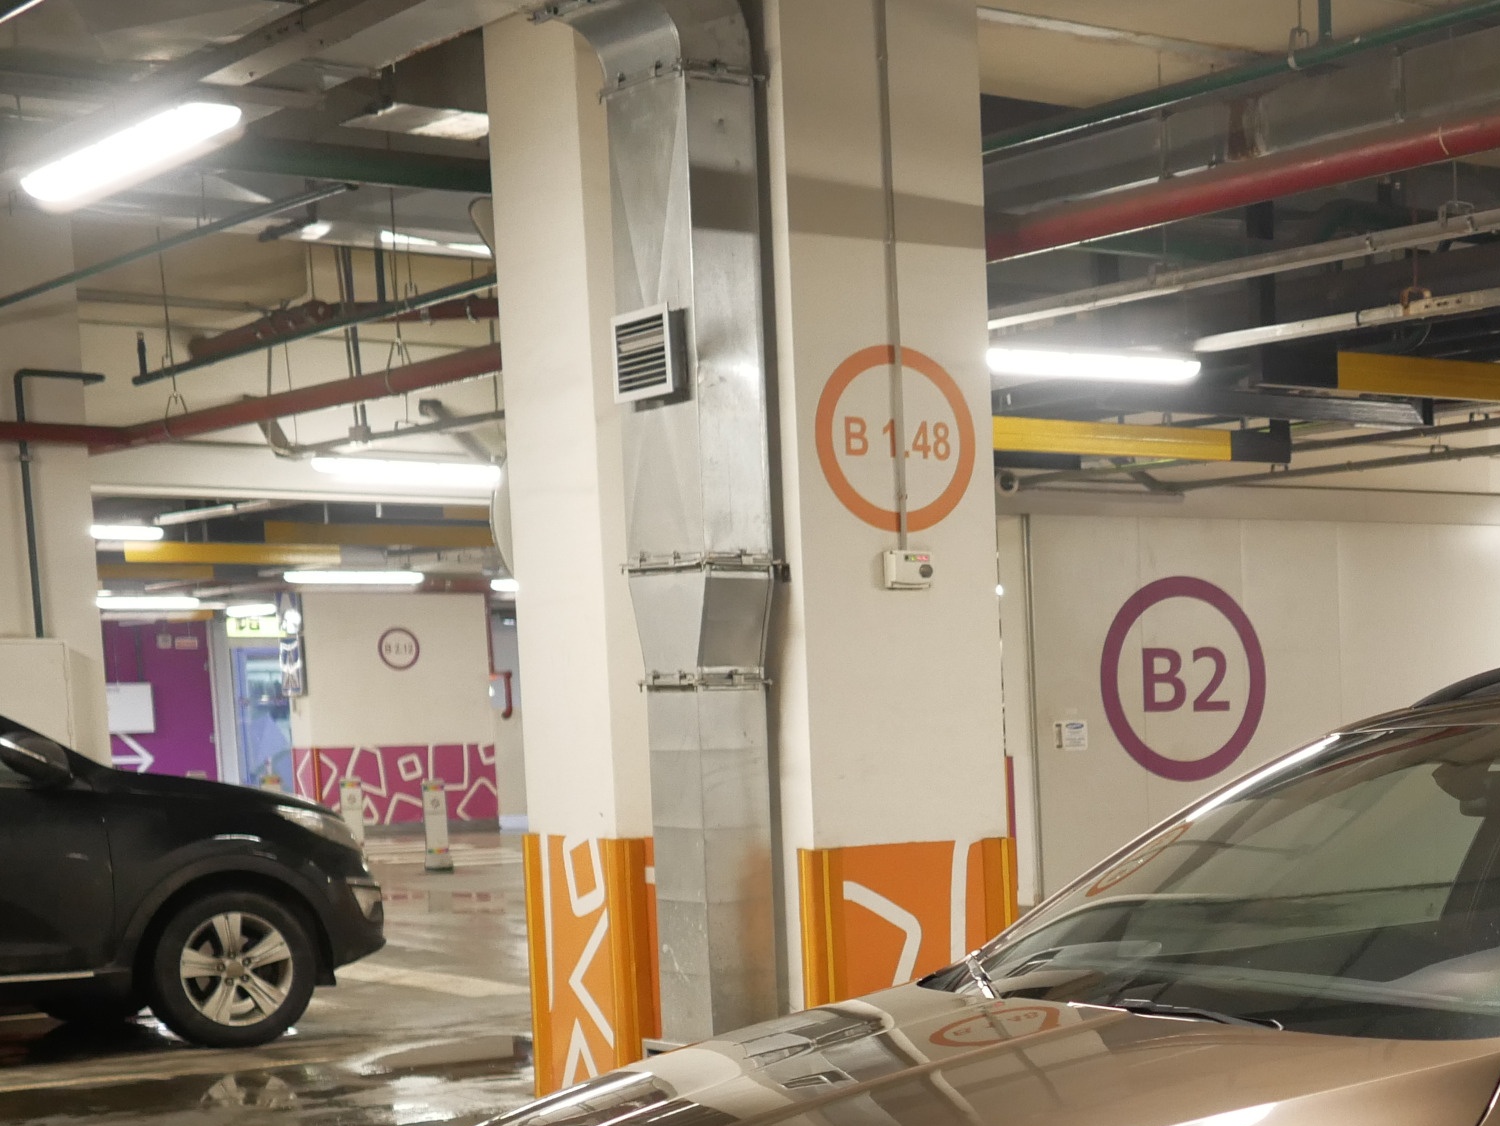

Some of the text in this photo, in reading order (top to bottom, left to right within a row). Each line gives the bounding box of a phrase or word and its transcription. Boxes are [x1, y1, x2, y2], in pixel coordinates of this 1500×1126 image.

[844, 416, 951, 461] B 1.48
[1142, 646, 1231, 713] B2
